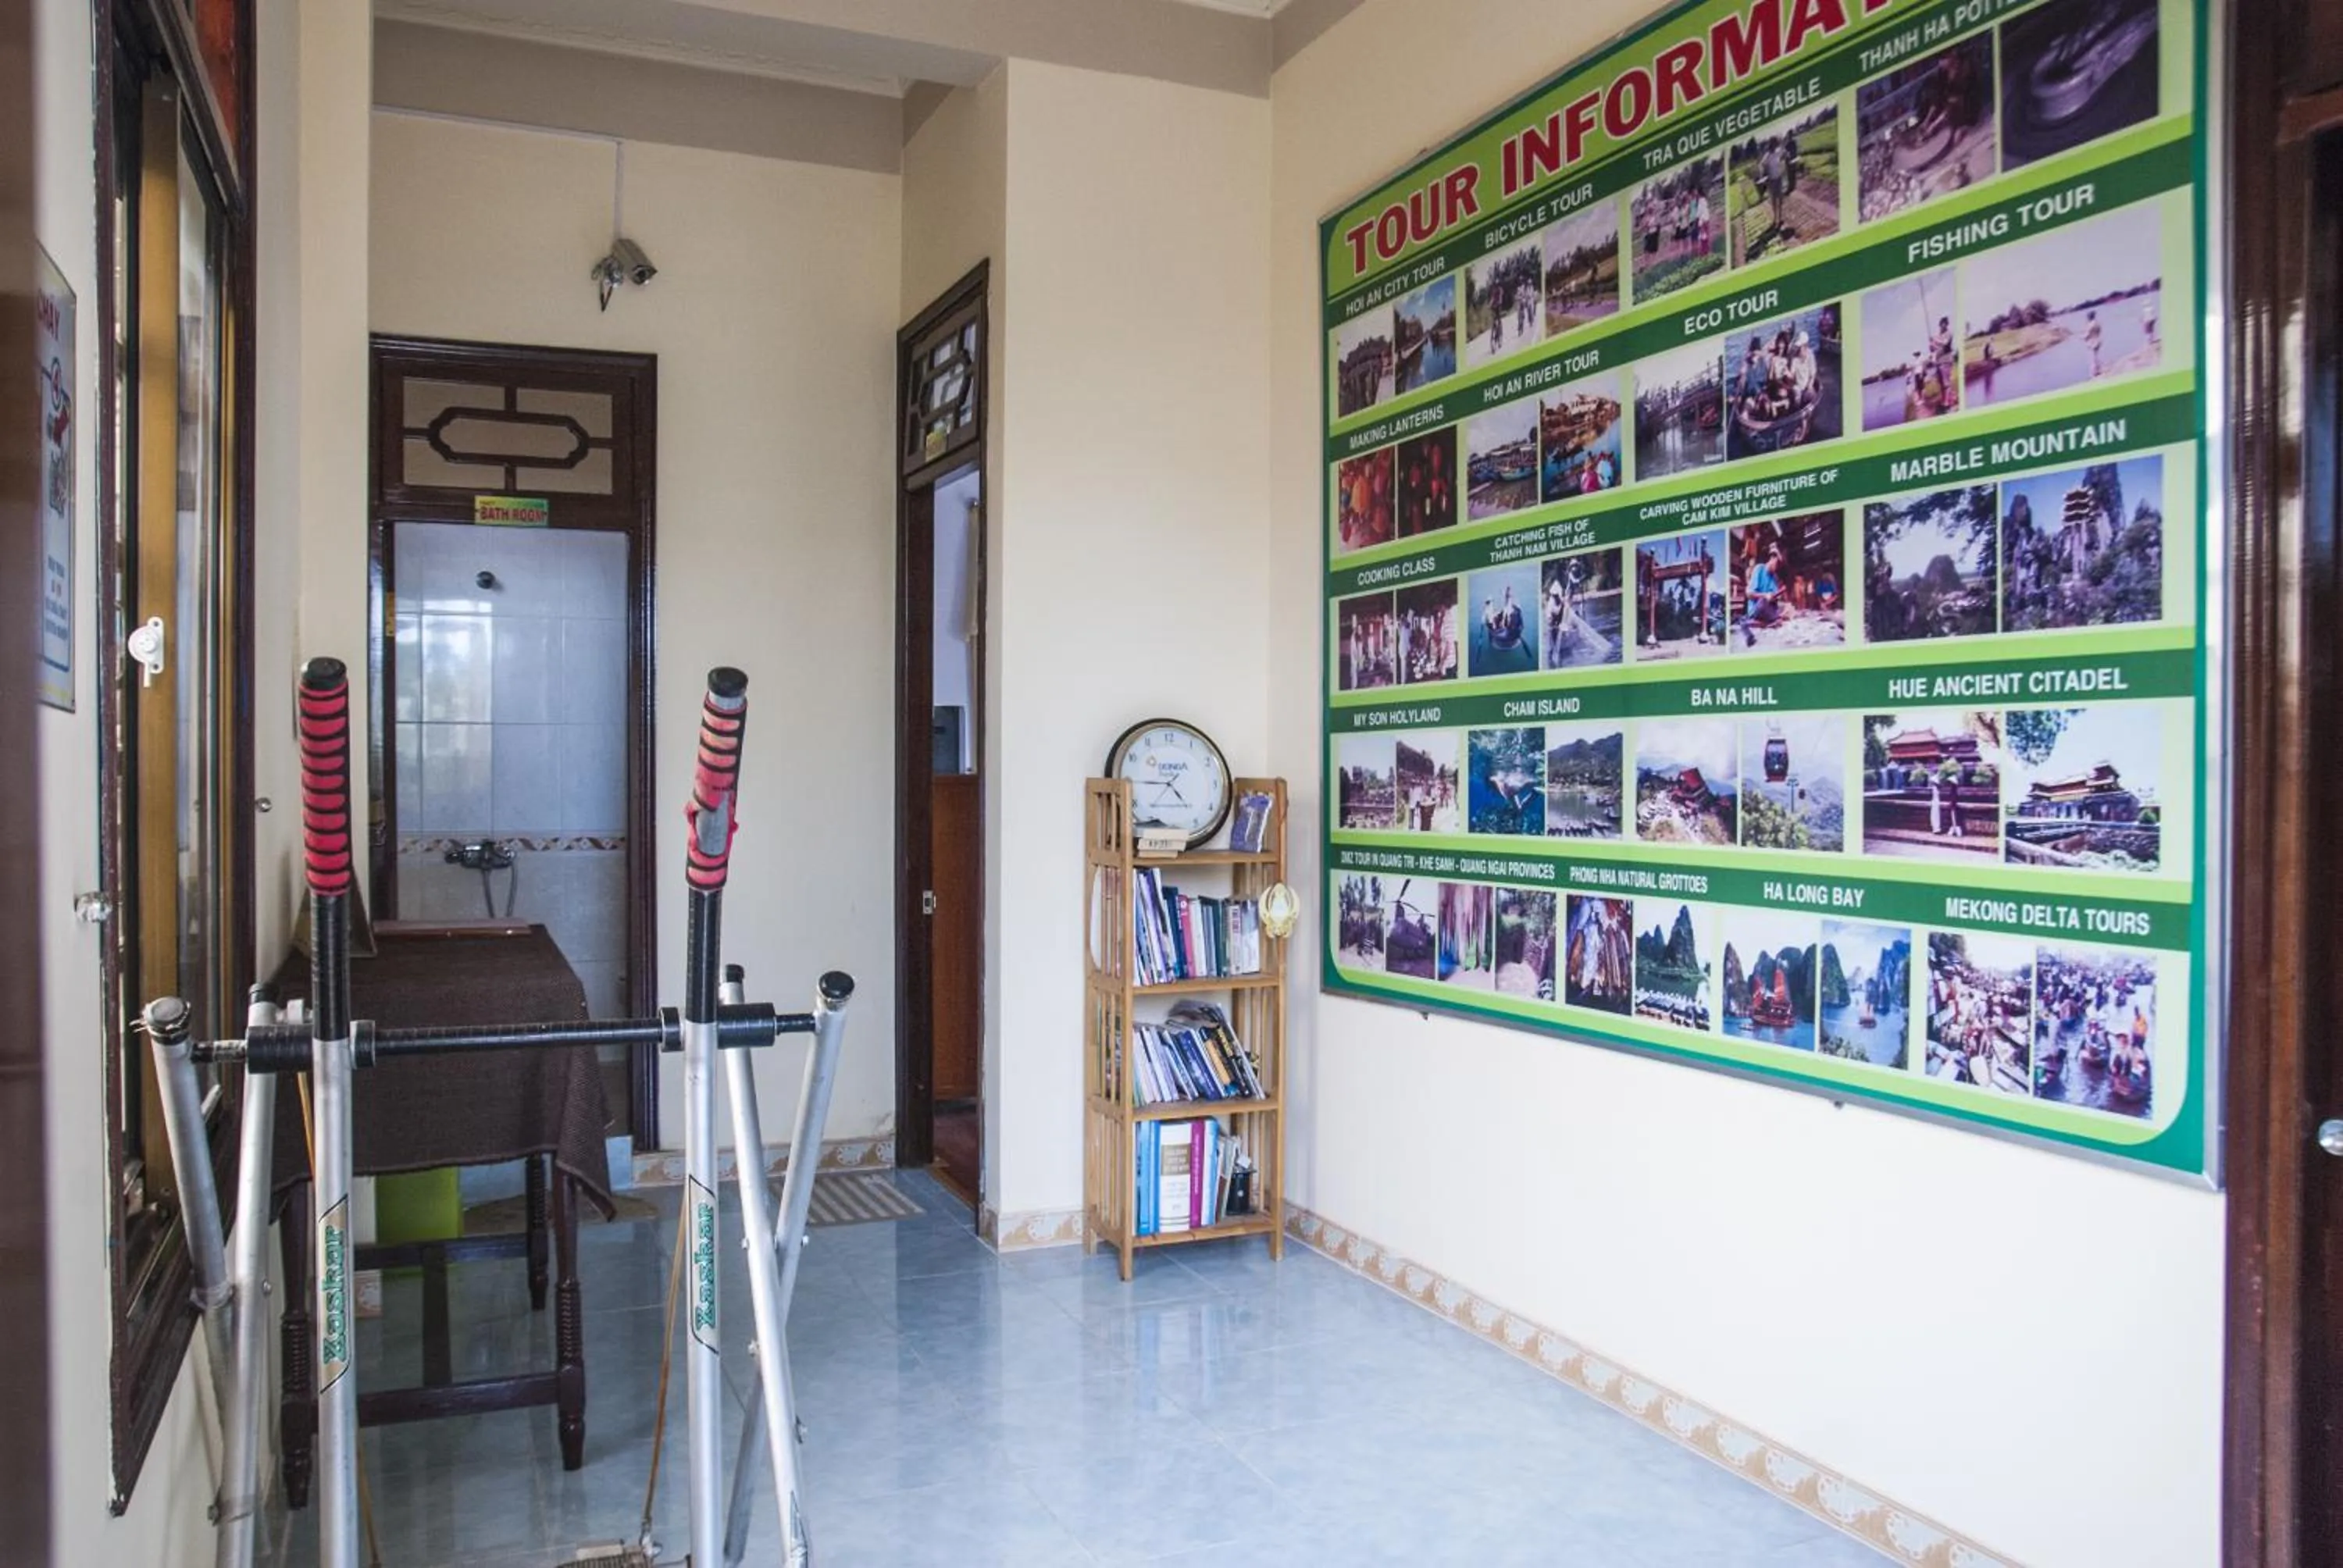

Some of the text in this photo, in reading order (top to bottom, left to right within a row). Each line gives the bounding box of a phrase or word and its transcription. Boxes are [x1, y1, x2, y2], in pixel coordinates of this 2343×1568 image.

[1860, 28, 1919, 72] THANH
[1924, 16, 1950, 43] HA
[1346, 0, 1898, 275] TOUR INFORMA
[1643, 77, 1821, 170] TRA QUE VEGETABLE
[1485, 184, 1594, 249] BICYCLE TOUR
[1908, 184, 2095, 264] FISHING TOUR
[1346, 257, 1445, 317] HOI AN CITY TOUR
[1685, 289, 1779, 337] ECO TOUR
[1484, 350, 1599, 402] HOI AN RIVER TOUR
[1350, 404, 1443, 451] MAKING LANTERNS
[1890, 419, 2127, 483] MARBLE MOUNTAIN
[481, 506, 508, 520] BATH
[1639, 470, 1838, 521] CARVING WOODEN FURNITURE OF
[1681, 494, 1786, 526] CAM KIM VILLAGE
[1489, 531, 1597, 563] THANH NAM VILLAGE
[1494, 519, 1589, 548] CATCHING FISH OF
[1357, 557, 1435, 586] COOKING CLASS
[1691, 686, 1778, 707] BA NA HILL
[1888, 668, 2128, 699] HUE ANCIENT CITADEL
[1353, 707, 1441, 726] MY SON HOLYLAND
[1503, 698, 1580, 717] CHAM ISLAND
[1355, 852, 1371, 865] TOUR
[1379, 853, 1402, 867] QUANG
[1403, 854, 1414, 868] TRI
[1420, 855, 1433, 869] KHE
[1435, 857, 1454, 871] SANH
[1460, 858, 1485, 874] QUANG
[1488, 861, 1507, 875] NGAI
[1509, 862, 1554, 879] PROVINCES
[1570, 867, 1707, 893] PHONG NHA NATURAL GROTTOES
[1764, 882, 1864, 908] HA LONG BAY
[1946, 897, 2150, 936] MEKONG DELTA TOURS
